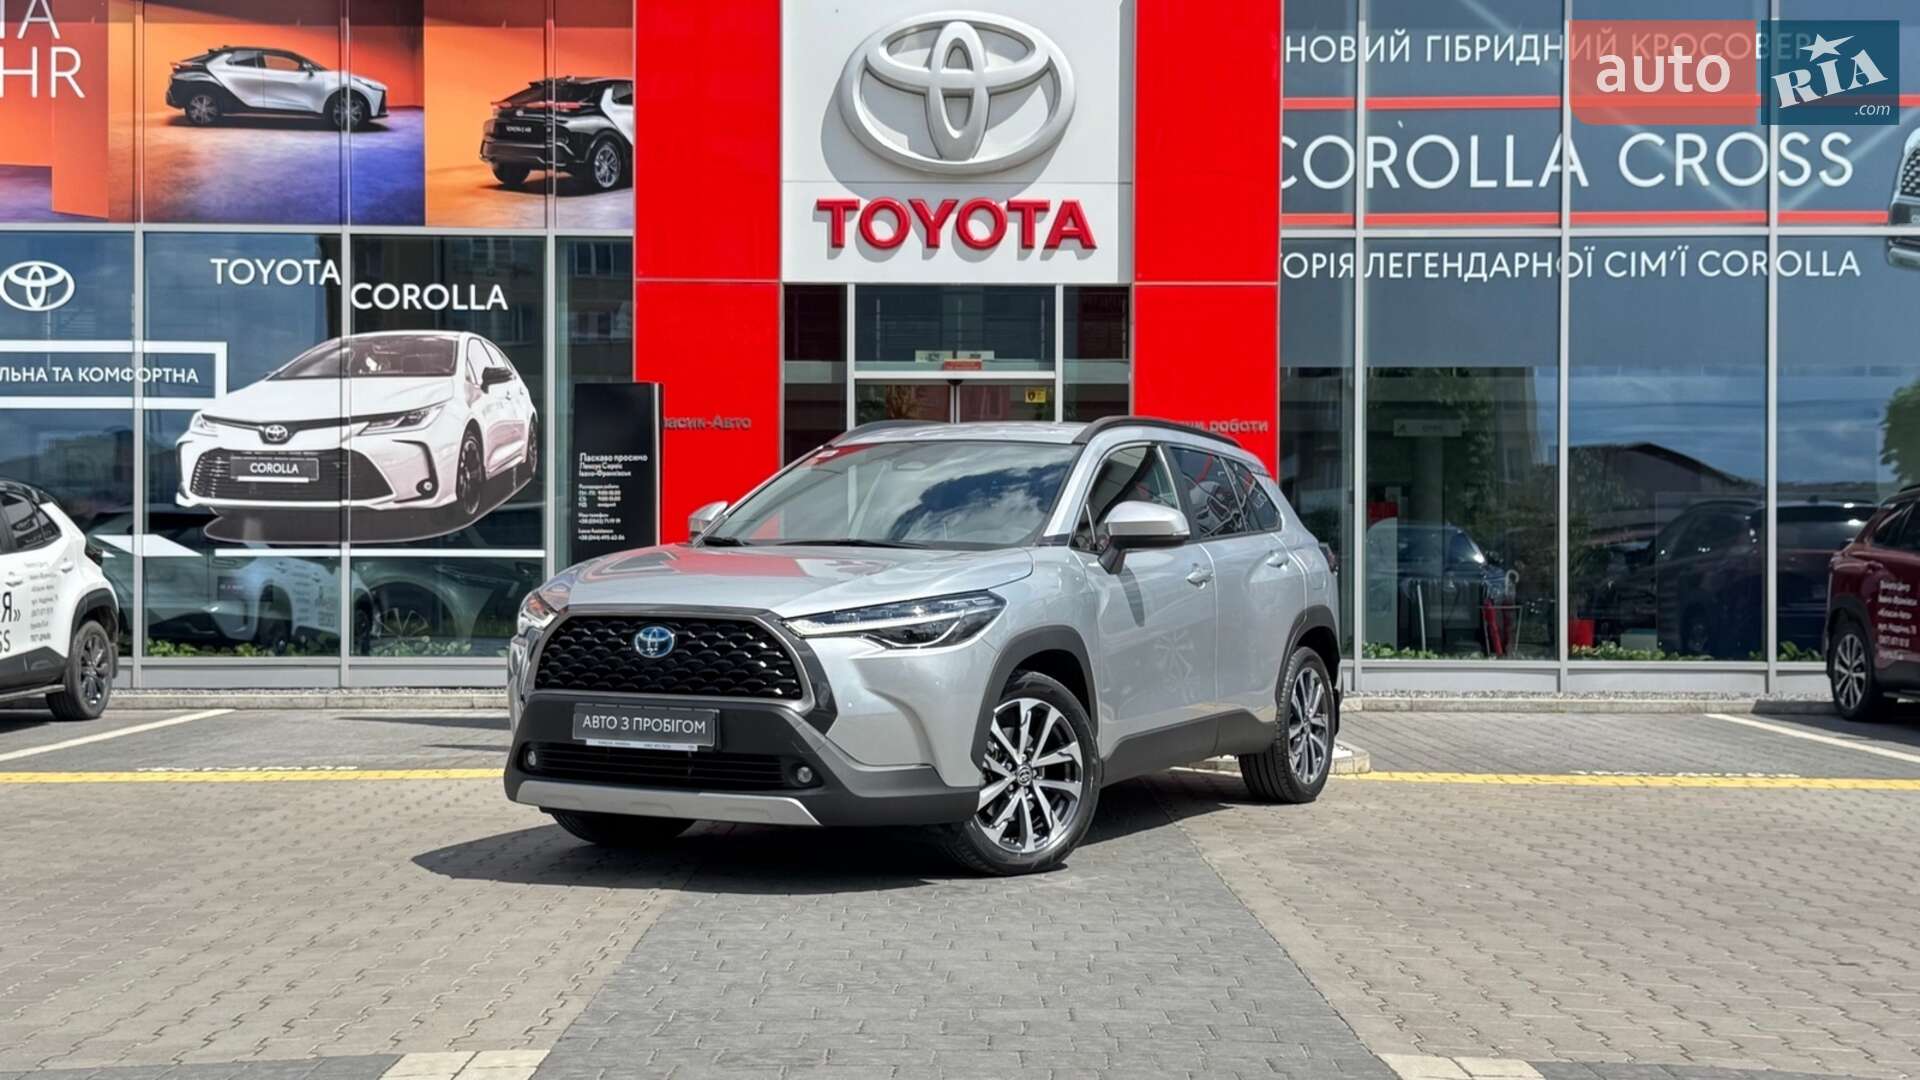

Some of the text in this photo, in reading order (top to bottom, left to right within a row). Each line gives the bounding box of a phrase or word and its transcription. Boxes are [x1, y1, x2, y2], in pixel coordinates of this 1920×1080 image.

[1285, 29, 1411, 63] НОВИЙ
[1426, 27, 1617, 66] ГІБРИДНИЙ
[1618, 131, 1854, 187] CROSS
[816, 197, 1098, 251] TOYOTA
[210, 258, 342, 286] TOYOTA
[1281, 252, 1354, 279] ОРІЯ
[1364, 246, 1595, 283] ЛЕГЕНДАРНОЇ
[1698, 250, 1861, 278] COROLLA
[350, 283, 509, 310] COROLLA
[52, 367, 73, 383] ТА
[78, 366, 199, 384] КОМФОРТНА
[250, 462, 299, 474] COROLLA
[582, 715, 618, 730] АВТО
[632, 717, 706, 735] ПРОБІГОМ
